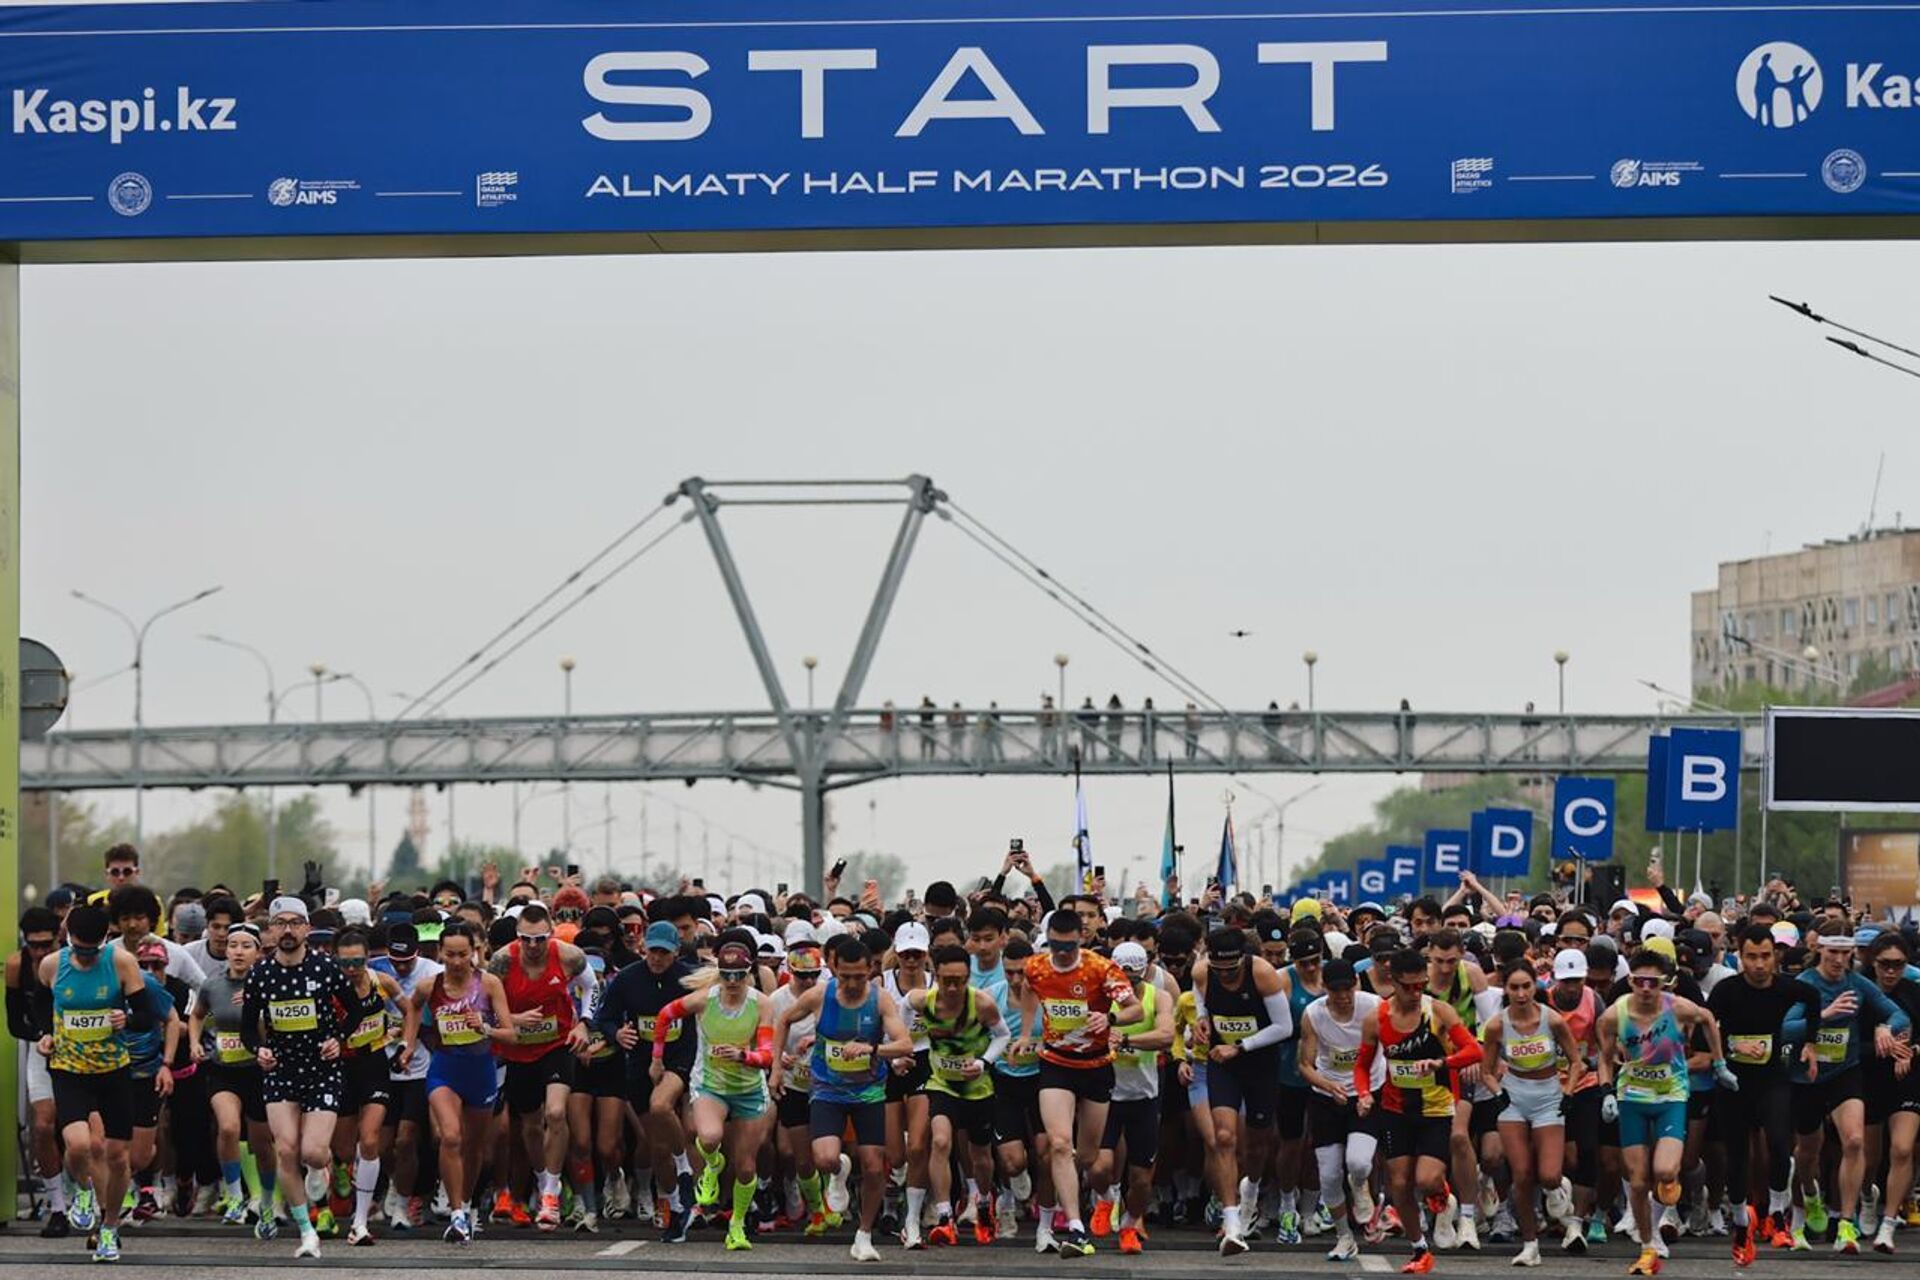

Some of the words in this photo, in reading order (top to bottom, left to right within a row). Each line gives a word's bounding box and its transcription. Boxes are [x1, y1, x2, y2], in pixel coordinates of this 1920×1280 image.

[582, 40, 1388, 141] START
[1846, 63, 1920, 108] Ka
[13, 86, 237, 144] Kaspi.kz
[586, 173, 790, 197] ALMATY
[804, 171, 938, 194] HALF
[954, 166, 1244, 192] MARATHON
[1260, 164, 1388, 188] 2026
[1637, 171, 1681, 187] AIMS
[295, 190, 338, 205] AIMS
[1682, 755, 1726, 801] B
[1564, 798, 1607, 836] C
[1491, 825, 1525, 857] D
[1435, 844, 1460, 872] E
[1393, 858, 1415, 882] F
[1328, 880, 1348, 902] H
[1360, 871, 1386, 894] G
[70, 1015, 105, 1028] 4977
[275, 1005, 310, 1018] 4250
[1050, 1004, 1081, 1017] 5816
[448, 1022, 466, 1032] 817
[1219, 1020, 1252, 1032] 4323
[221, 1038, 243, 1050] 807
[1511, 1042, 1544, 1057] 8065
[1633, 1067, 1667, 1080] 5093
